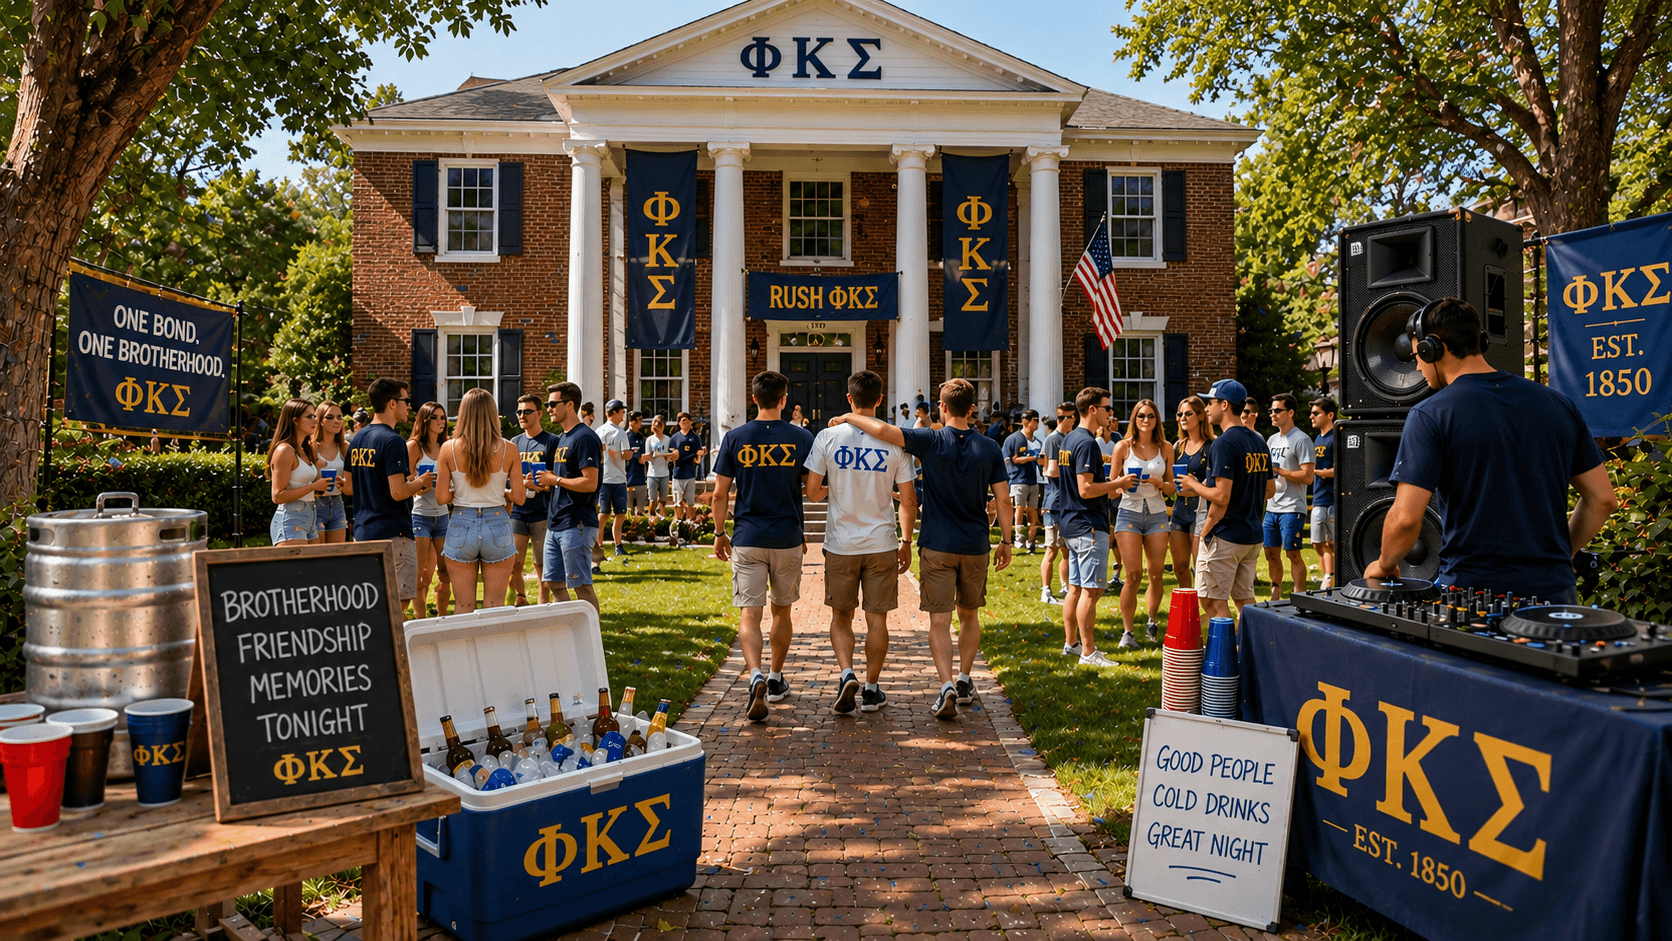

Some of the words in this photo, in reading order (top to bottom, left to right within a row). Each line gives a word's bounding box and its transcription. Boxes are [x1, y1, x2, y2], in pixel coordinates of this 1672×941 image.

[769, 284, 824, 309] RUSH
[828, 285, 879, 310] ΦΚΣ
[1564, 261, 1671, 315] ΦΚΣ
[113, 304, 149, 334] ONE
[78, 330, 115, 360] ONE
[118, 339, 225, 379] BROTHERHOOD.
[1591, 333, 1644, 360] EST.
[115, 376, 191, 418] ΦΚΣ
[1585, 367, 1652, 397] 1850
[737, 443, 797, 468] ΦΚΣ
[833, 444, 890, 473] ΦΚΣ
[221, 582, 379, 623] BROTHERHOOD
[237, 621, 372, 664] FRIENDSHIP
[250, 663, 372, 704] MEMORIES
[256, 703, 368, 743] TONIGHT
[272, 744, 365, 786] ΦΚΣ
[1156, 744, 1204, 774] GOOD
[1209, 753, 1276, 786] PEOPLE
[1297, 680, 1552, 881] ΦΚΣ
[1152, 783, 1198, 811] COLD
[1204, 792, 1271, 825] DRINKS
[523, 793, 672, 888] ΦΚΣ
[1147, 821, 1206, 853] GREAT
[1210, 833, 1269, 866] NIGHT
[1353, 823, 1402, 869] EST.
[1410, 851, 1466, 899] 1850
